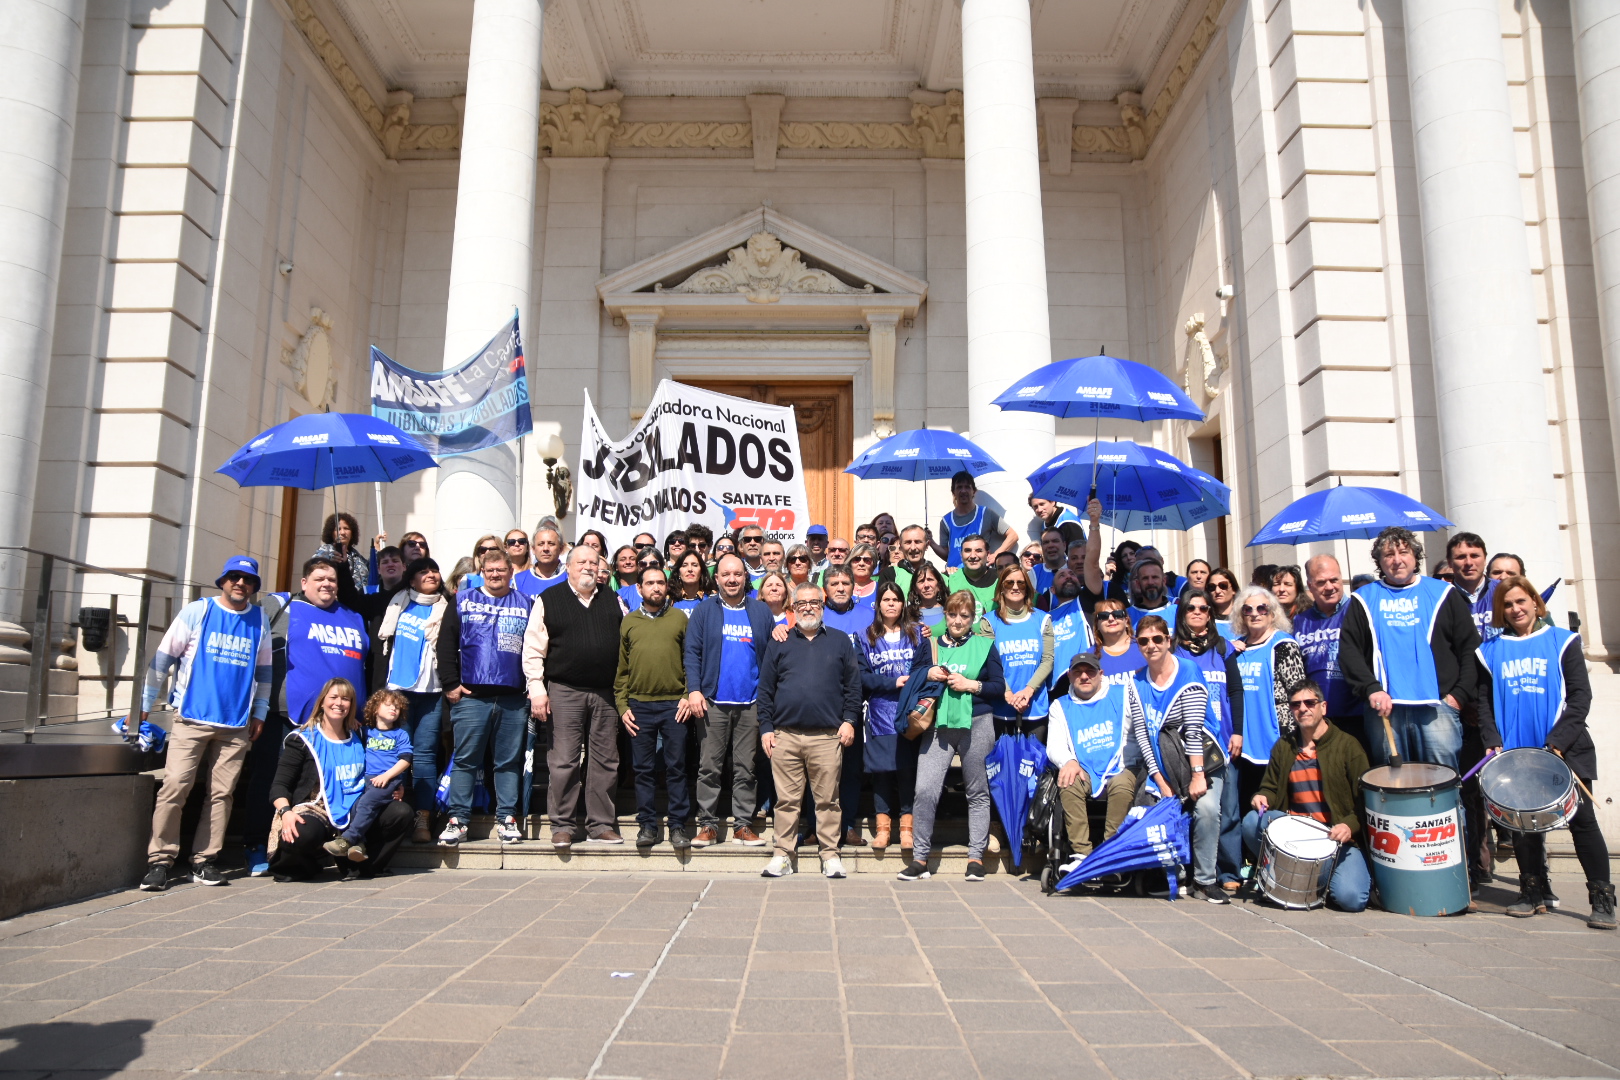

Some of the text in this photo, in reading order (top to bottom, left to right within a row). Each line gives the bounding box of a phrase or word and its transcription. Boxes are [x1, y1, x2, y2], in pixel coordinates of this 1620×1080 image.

[458, 370, 483, 384] La
[716, 405, 786, 433] Nacional
[722, 492, 792, 506] SANTA FE
[578, 502, 590, 516] Y
[498, 616, 527, 627] SOMOS
[1395, 613, 1415, 621] Capit
[307, 622, 362, 650] AMSAFE
[722, 624, 752, 638] AMSAFE
[1295, 628, 1341, 646] festra
[206, 632, 252, 654] AMSAFE
[1000, 638, 1039, 656] AMSAFE
[205, 647, 218, 655] San
[870, 648, 916, 667] festra
[1520, 676, 1538, 685] pital
[1092, 736, 1113, 745] Capita
[1377, 817, 1390, 831] FE
[1415, 818, 1443, 829] SANTA
